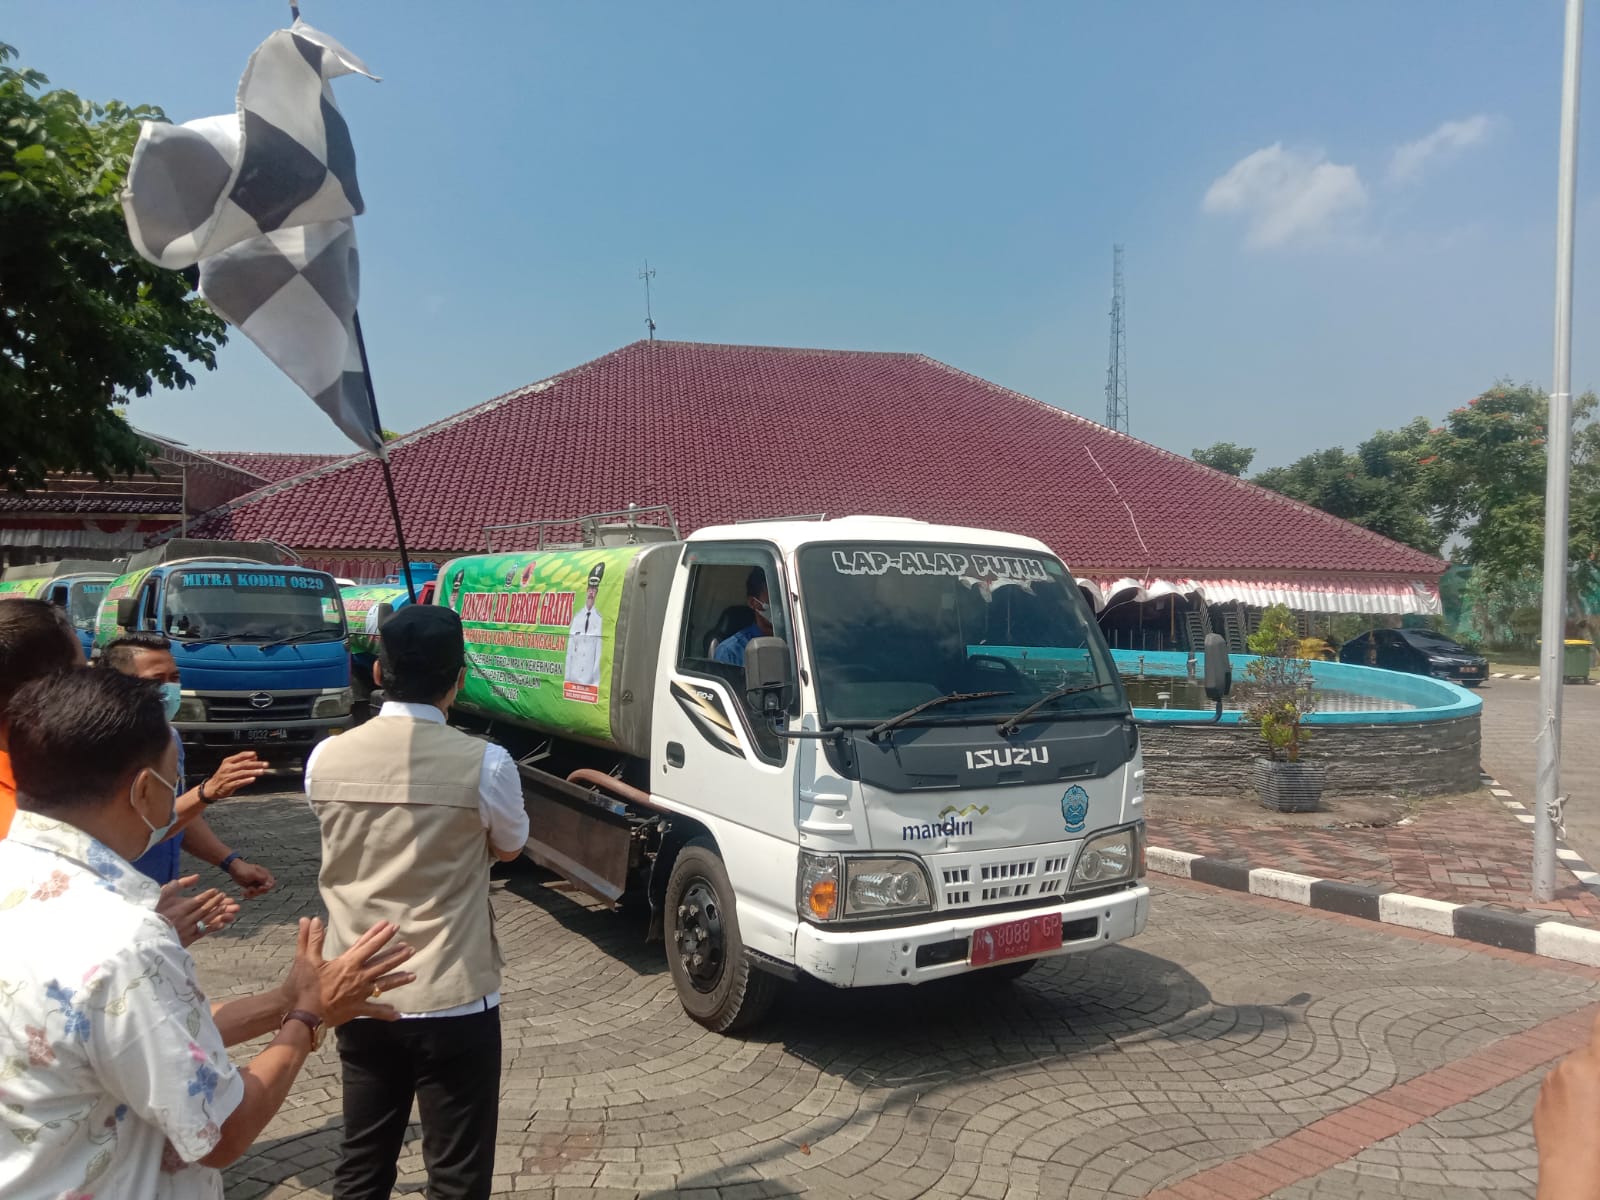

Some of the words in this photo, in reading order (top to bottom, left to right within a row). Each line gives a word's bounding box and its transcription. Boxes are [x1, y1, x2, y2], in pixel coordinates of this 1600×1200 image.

[832, 551, 967, 575] LAP-ALAP
[971, 554, 1048, 581] PUTIH
[182, 573, 232, 587] MITRA
[237, 574, 286, 587] KODIM
[290, 576, 324, 590] 0829
[493, 593, 509, 622] AIR
[508, 592, 541, 625] BERSIH
[540, 592, 576, 627] GRATIS
[527, 633, 566, 652] BANGKALAN
[966, 746, 1049, 770] ISUZU
[902, 816, 973, 841] mandiri
[998, 921, 1031, 947] 8088
[1042, 915, 1059, 937] GP
